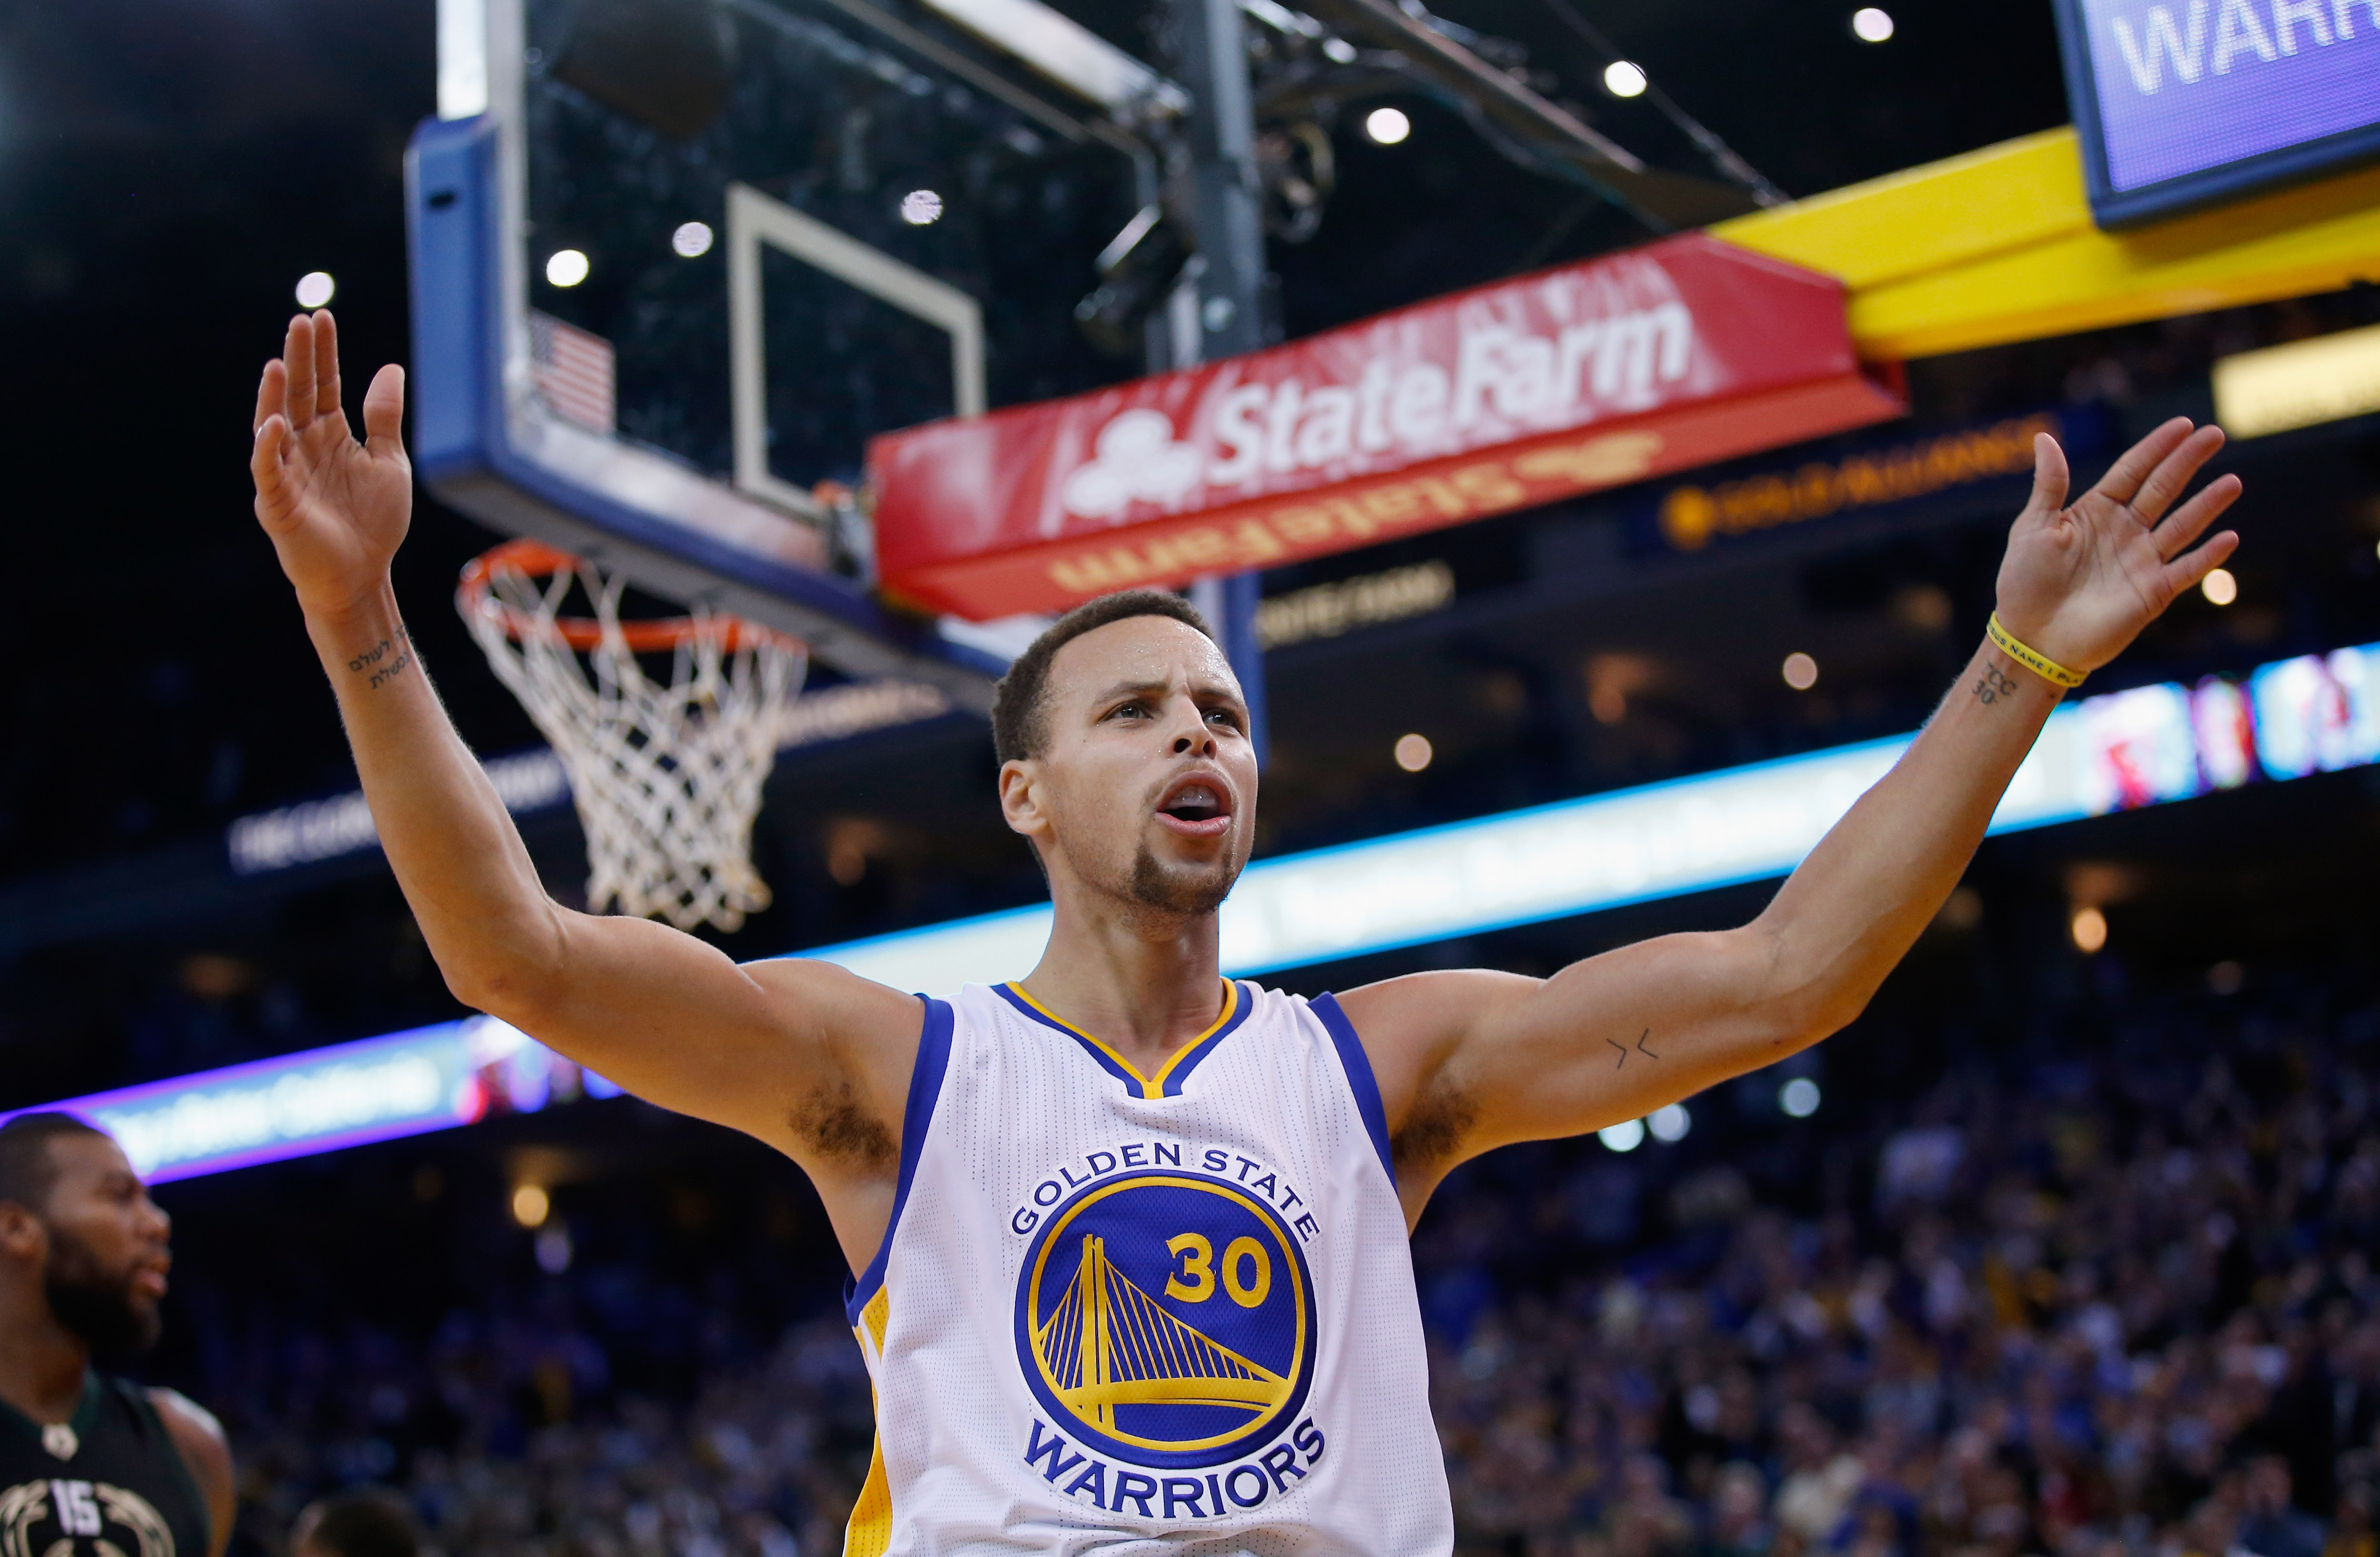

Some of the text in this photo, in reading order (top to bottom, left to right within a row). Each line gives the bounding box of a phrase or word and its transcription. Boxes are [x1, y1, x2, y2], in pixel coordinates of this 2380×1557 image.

[2010, 644, 2044, 670] NAME
[1971, 680, 1996, 704] 30
[1011, 1142, 1320, 1244] GOLDEN STATE
[1164, 1232, 1271, 1308] 30
[1024, 1416, 1326, 1519] WARRIORS
[50, 1478, 102, 1537] 15
